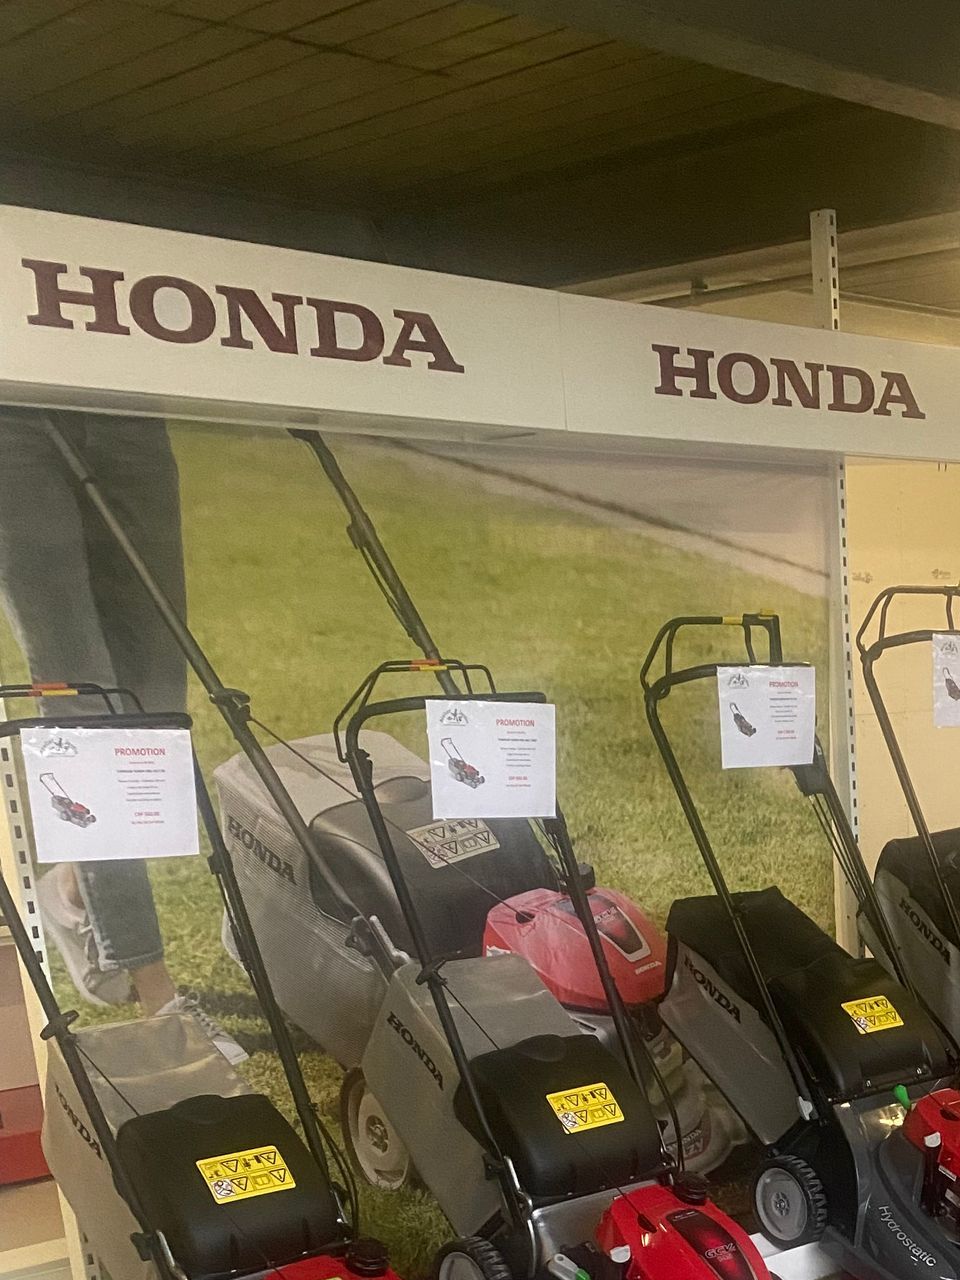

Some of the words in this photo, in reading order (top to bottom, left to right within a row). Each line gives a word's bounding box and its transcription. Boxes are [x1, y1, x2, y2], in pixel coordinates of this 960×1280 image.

[21, 258, 465, 373] HONDA
[652, 344, 926, 420] HONDA
[114, 748, 166, 756] PROMOTION
[496, 719, 535, 727] PROMOTION
[227, 815, 297, 886] HONDA
[899, 898, 951, 967] HONDA
[684, 953, 741, 1025] HONDA
[387, 1011, 443, 1091] HONDA
[879, 1205, 937, 1267] Hydrostatic
